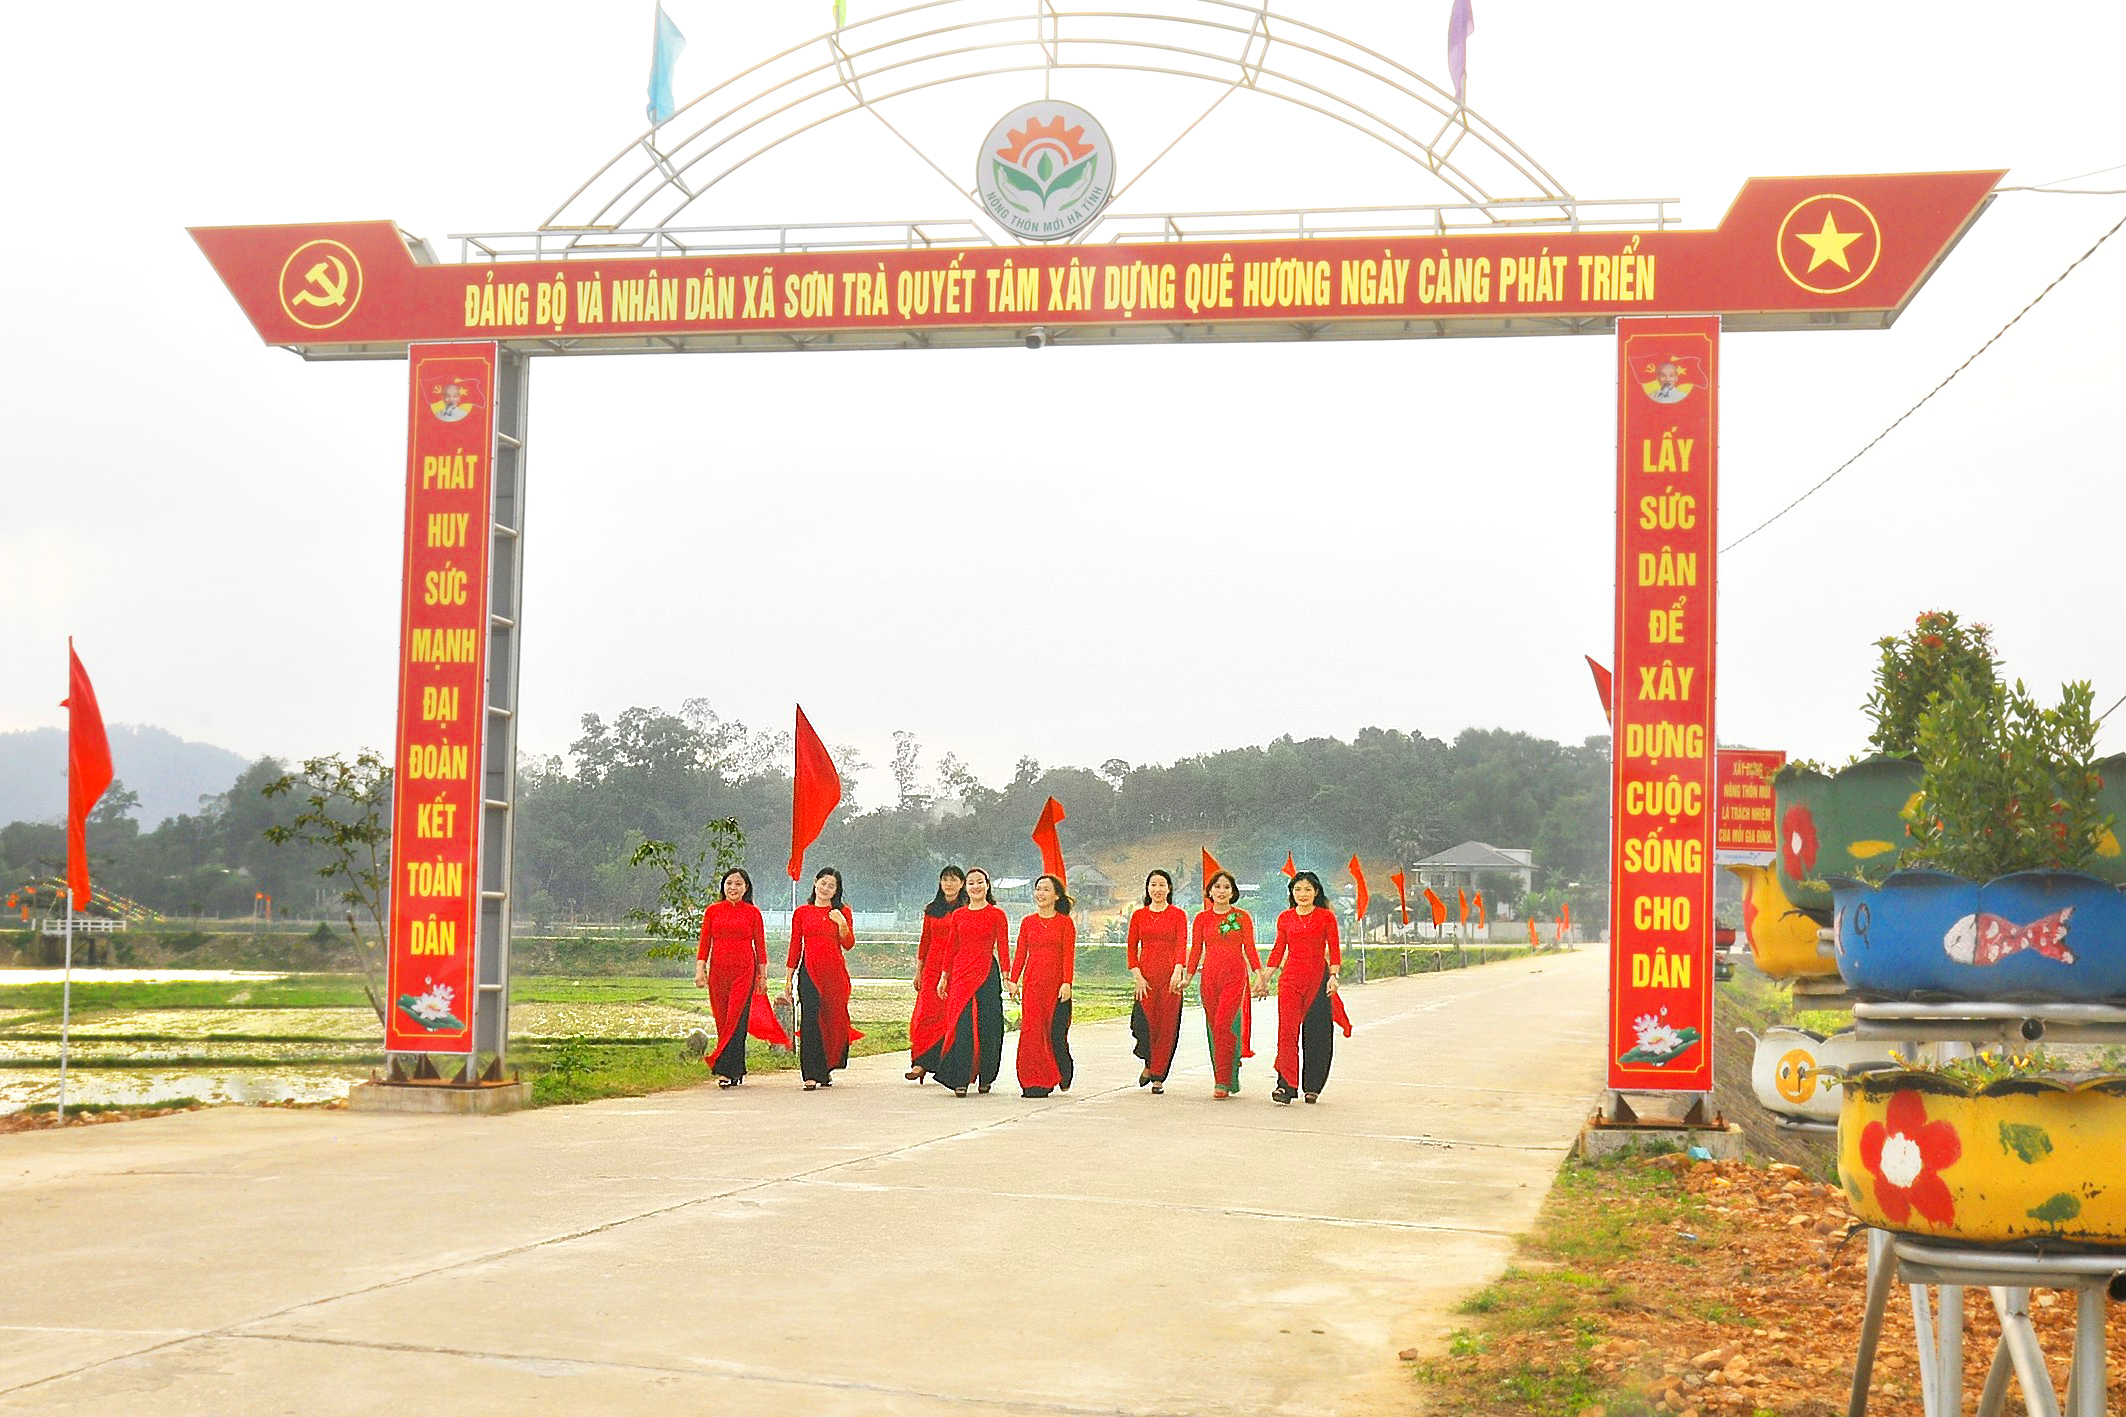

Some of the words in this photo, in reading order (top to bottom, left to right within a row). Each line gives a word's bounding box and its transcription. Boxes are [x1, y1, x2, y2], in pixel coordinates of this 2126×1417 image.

[986, 191, 1010, 220] NÔNG
[1011, 215, 1039, 232] THÔN
[1043, 217, 1065, 232] MỚI
[1068, 209, 1084, 225] HÀ
[1083, 186, 1103, 212] TĨNH
[465, 270, 529, 327] ĐẢNG
[536, 272, 566, 331] BỘ
[577, 271, 603, 323] VÀ
[612, 269, 678, 322] NHÂN
[685, 268, 735, 320] DÂN
[742, 267, 775, 318] XÃ
[784, 271, 834, 318] SƠN
[842, 262, 888, 316] TRÀ
[898, 252, 976, 320] QUYẾT
[987, 259, 1039, 312] TÂM
[1048, 257, 1096, 311] XÂY
[1104, 260, 1176, 318] DỰNG
[1185, 253, 1234, 314] QUÊ
[1243, 257, 1330, 307] HƯƠNG
[1341, 249, 1410, 305] NGÀY
[1419, 248, 1490, 304] CÀNG
[1499, 247, 1568, 302] PHÁT
[1578, 235, 1655, 301] TRIỂN
[424, 448, 478, 489] PHÁT
[1644, 427, 1693, 472] LẤY
[1640, 486, 1695, 529] SỨC
[428, 513, 469, 547] HUY
[425, 561, 467, 605] SỨC
[1639, 546, 1696, 586] DÂN
[1649, 596, 1686, 643] ĐỂ
[412, 628, 476, 671] MẠNH
[1639, 660, 1694, 700] XÂY
[423, 687, 458, 728] ĐẠI
[410, 738, 467, 779] ĐOÀN
[1627, 721, 1703, 765] DỰNG
[418, 792, 456, 838] KẾT
[1627, 775, 1701, 823] CUỘC
[1731, 805, 1750, 820] TRÁCH
[1751, 805, 1771, 824] NHIỆM
[1625, 827, 1701, 873] SỐNG
[1745, 830, 1755, 843] GIA
[408, 855, 462, 897] TOÀN
[411, 914, 455, 955] DÂN
[1634, 896, 1690, 931] CHO
[1633, 947, 1690, 988] DÂN
